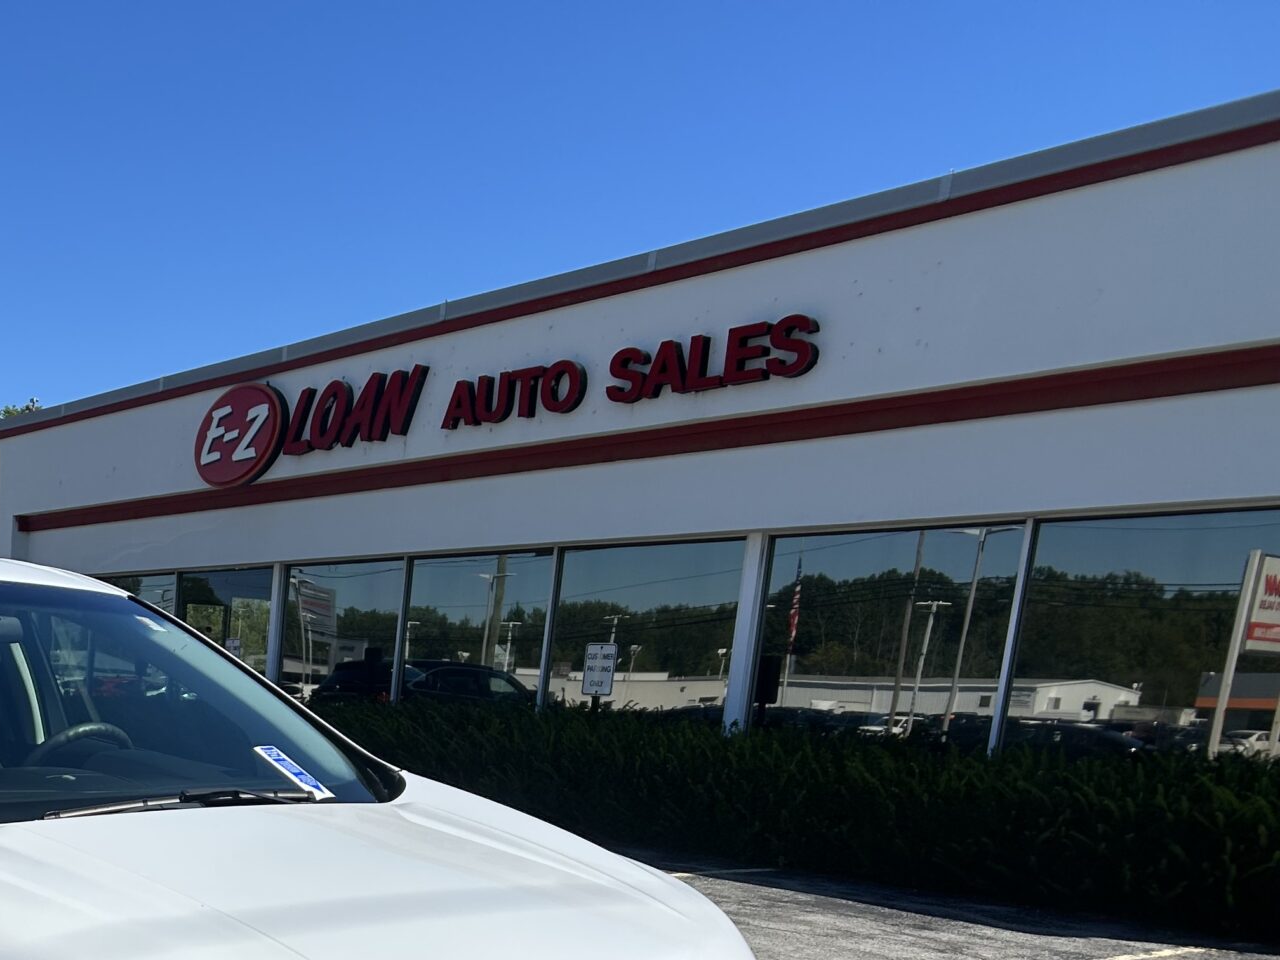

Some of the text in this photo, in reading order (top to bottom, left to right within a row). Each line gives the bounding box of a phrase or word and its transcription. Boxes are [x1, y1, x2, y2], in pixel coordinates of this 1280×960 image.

[200, 314, 820, 466] E-Z LOAN AUTO SALES
